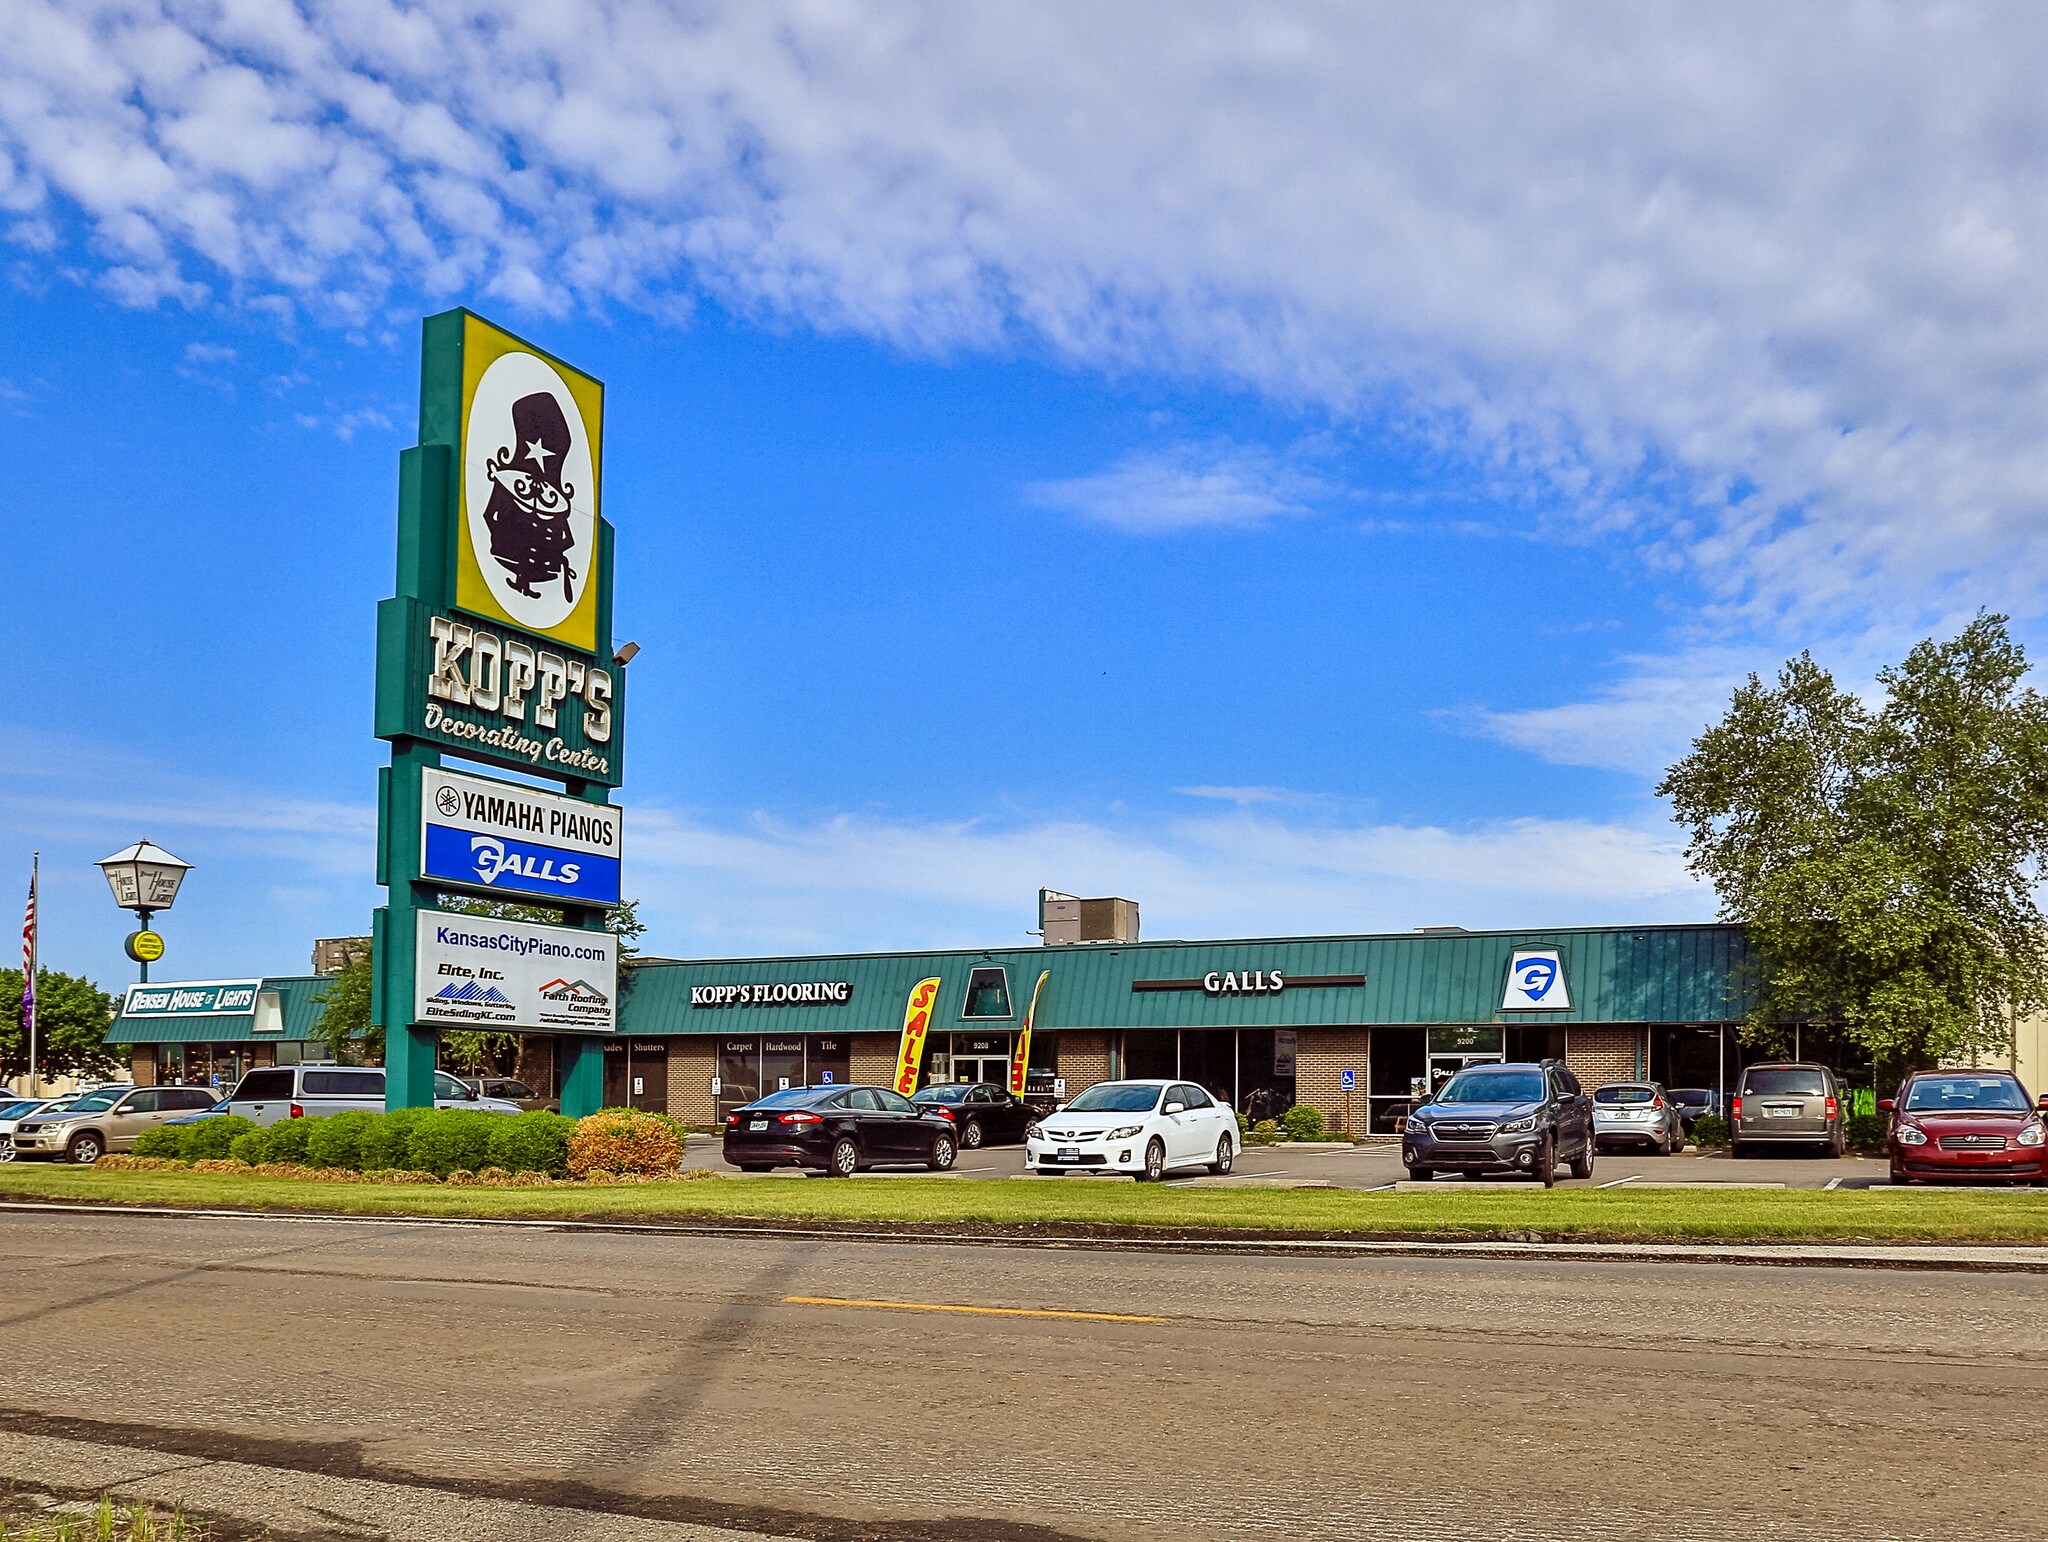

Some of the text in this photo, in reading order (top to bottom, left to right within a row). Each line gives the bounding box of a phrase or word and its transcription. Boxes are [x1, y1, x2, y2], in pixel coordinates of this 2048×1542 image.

[428, 616, 612, 742] KOPP'S
[424, 703, 610, 775] Decorating Center
[463, 791, 613, 847] YAMAHA PIANOS
[470, 836, 581, 884] GALLS
[437, 926, 606, 962] KansasCityPiano.com
[478, 967, 505, 981] Inc.
[1203, 969, 1284, 992] GALLS
[128, 991, 171, 1012] RENSEN
[167, 989, 206, 1011] HOUSE
[212, 988, 253, 1010] LIGHTS
[543, 991, 609, 1007] Faith Roofing
[690, 982, 849, 1005] KOPP'S FLOORING
[425, 1006, 517, 1022] EliteSidingKC.com
[567, 1003, 612, 1017] Company
[634, 1042, 665, 1052] Shutters
[726, 1041, 753, 1053] Carpet
[765, 1041, 802, 1051] Hardwood
[820, 1041, 837, 1050] Tile
[898, 984, 936, 1094] SALE
[973, 1041, 989, 1050] 9208
[1456, 1037, 1474, 1045] 9200
